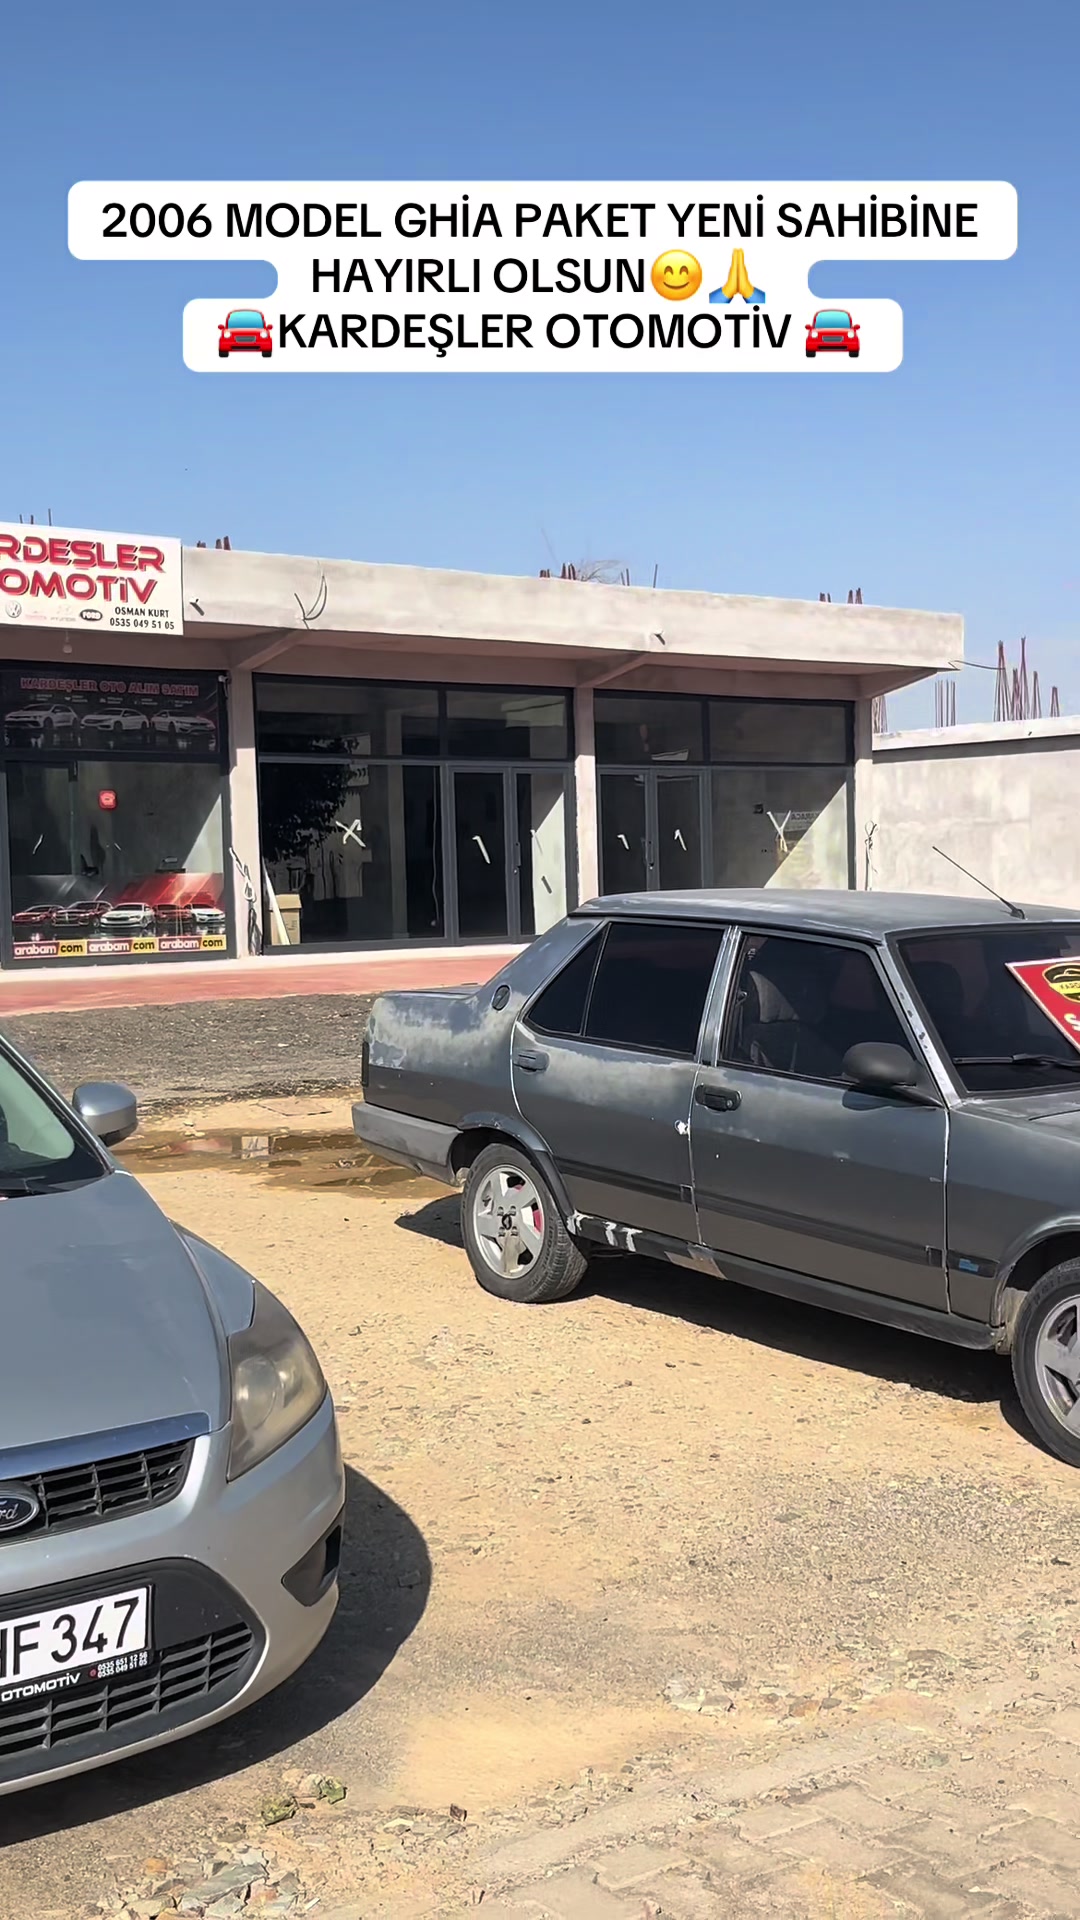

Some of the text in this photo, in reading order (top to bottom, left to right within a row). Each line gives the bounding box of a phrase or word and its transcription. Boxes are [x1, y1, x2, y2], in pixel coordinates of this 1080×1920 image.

[82, 611, 101, 620] FORD
[115, 606, 169, 618] OSMAN KURT
[110, 617, 175, 630] 0535 049 51 05
[20, 677, 199, 697] KARDEŞLER OTO ALIM SATIM
[14, 943, 84, 956] arabam com
[88, 940, 155, 953] arabam com
[160, 937, 223, 950] arabam com
[51, 1596, 139, 1664] 347
